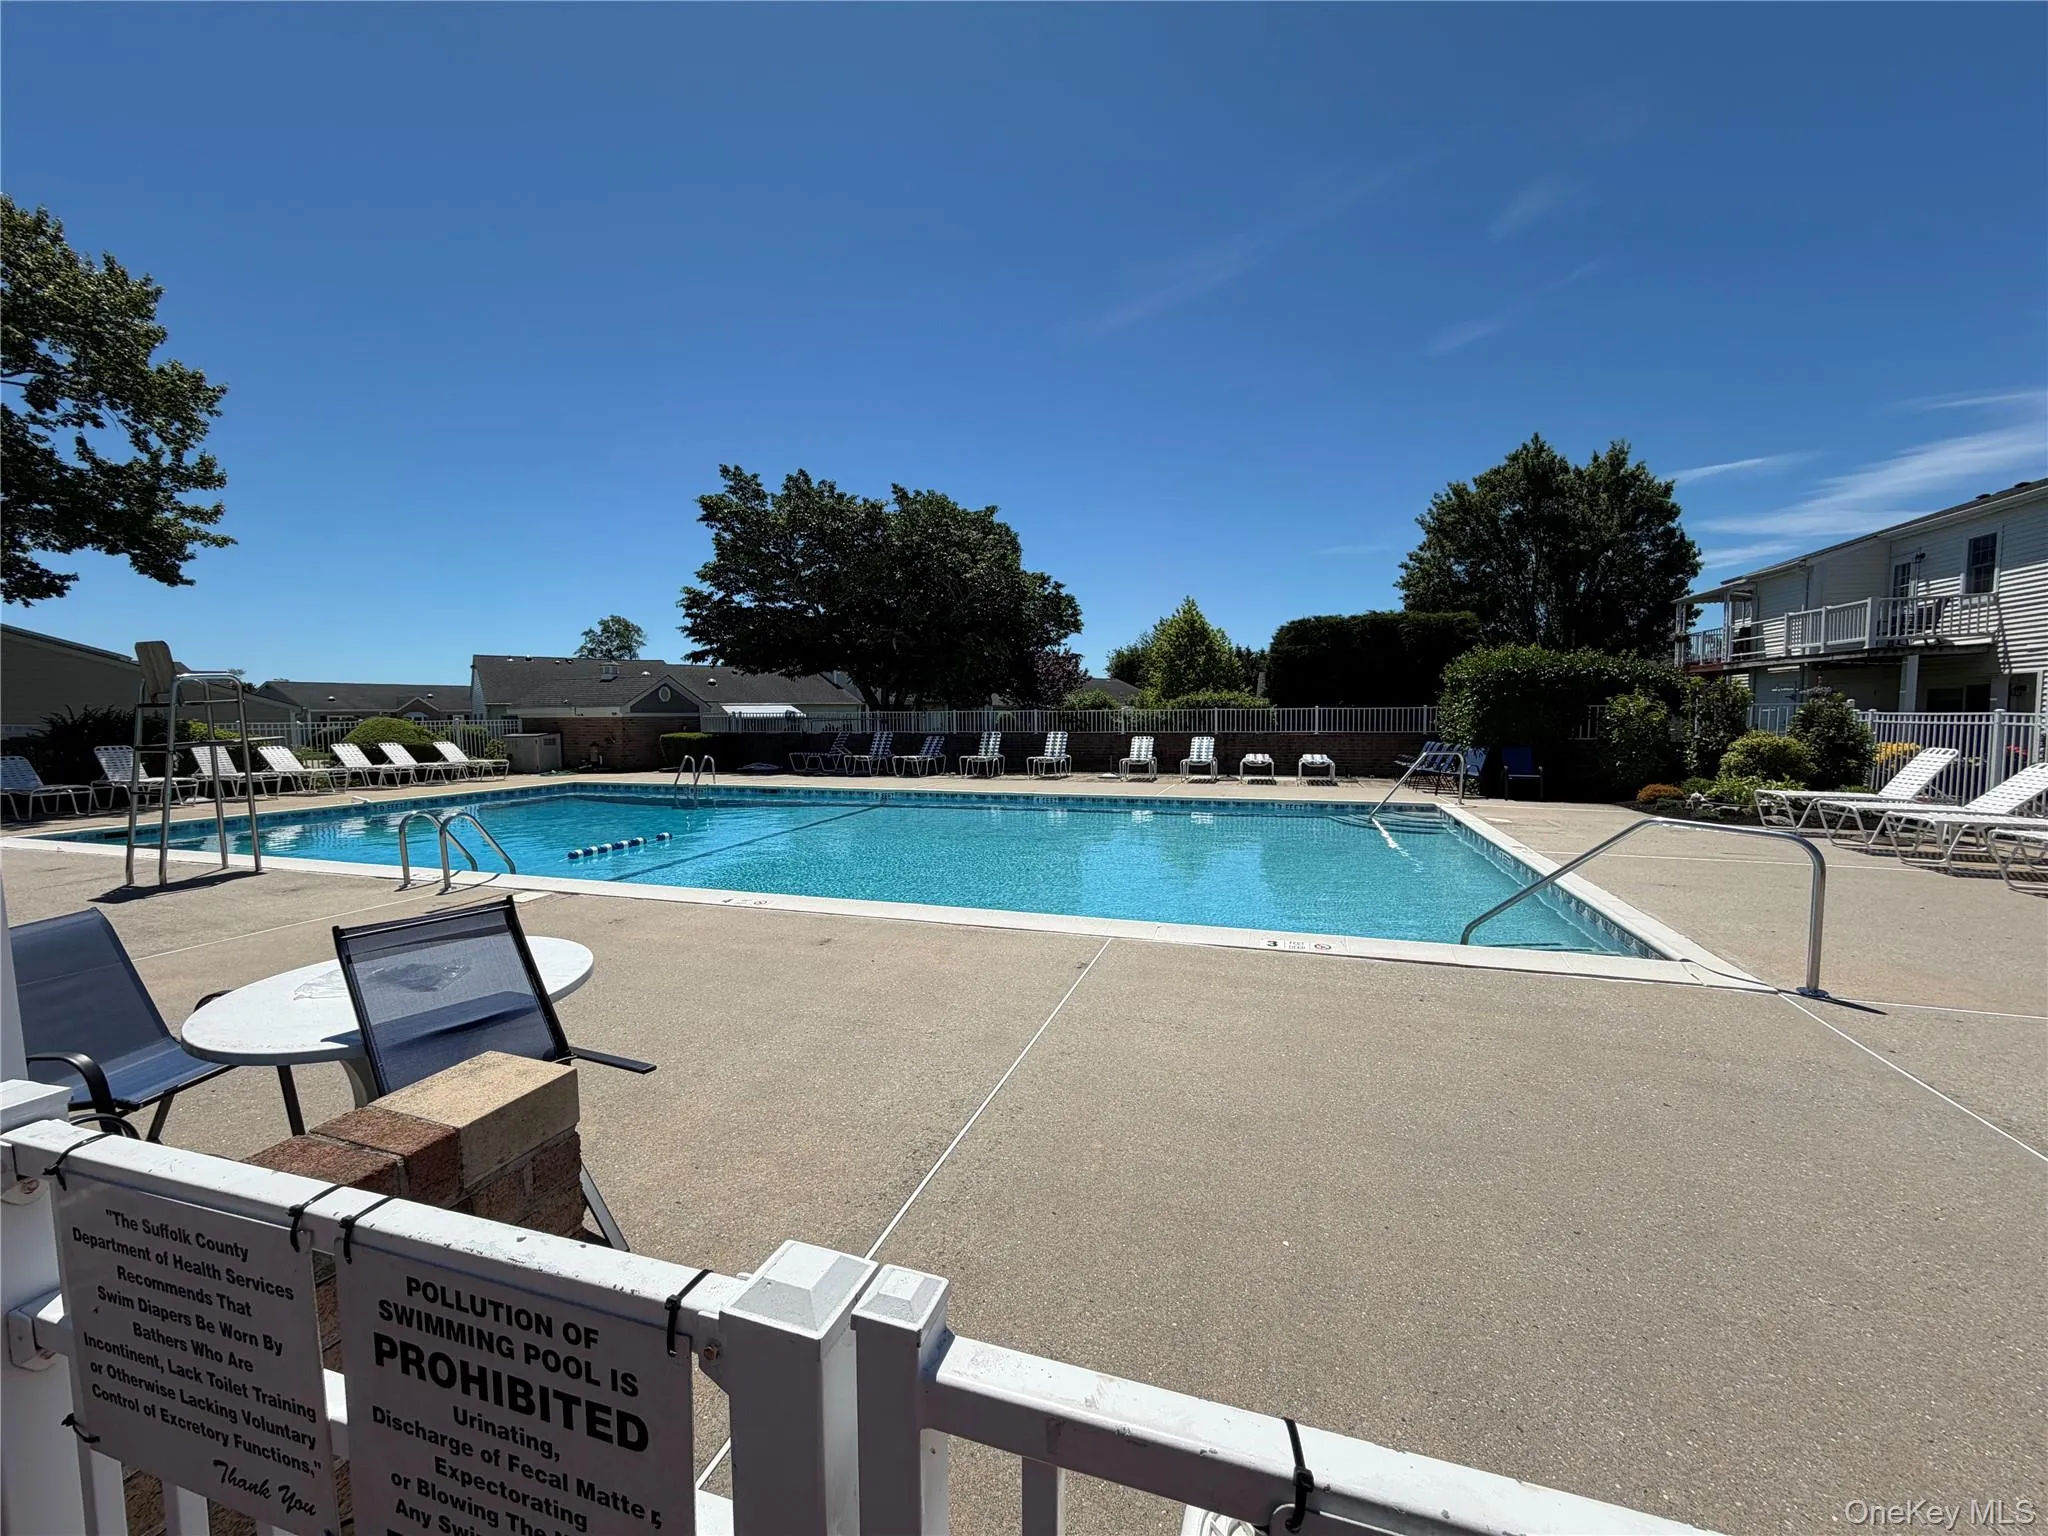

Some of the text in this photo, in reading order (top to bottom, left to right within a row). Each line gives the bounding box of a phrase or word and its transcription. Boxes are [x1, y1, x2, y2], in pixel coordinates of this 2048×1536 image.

[72, 1226, 294, 1300] Department of Health Services
[106, 1208, 248, 1262] "The Suffolk County
[97, 1285, 282, 1356] Swim Diapers Be Worn By
[117, 1265, 252, 1317] Recommends That
[406, 1276, 599, 1349] POLLUTION OF
[84, 1332, 317, 1423] Incontinent, Lack Toilet Training
[133, 1321, 254, 1373] Bathers Who Are
[378, 1298, 639, 1397] SWIMMING POOL IS
[90, 1361, 316, 1450] or Otherwise Lacking Voluntary
[92, 1383, 140, 1412] Control
[144, 1403, 156, 1418] of
[160, 1410, 229, 1447] Excretory
[373, 1331, 649, 1452] PROHIBITED
[372, 1405, 474, 1457] Discharge
[480, 1449, 502, 1467] of
[508, 1454, 569, 1493] Fecal
[453, 1405, 560, 1463] Urinating,
[213, 1459, 317, 1516] Thank You
[390, 1471, 547, 1536] or Blowing The
[395, 1498, 432, 1529] Any
[435, 1456, 588, 1533] Expectorating
